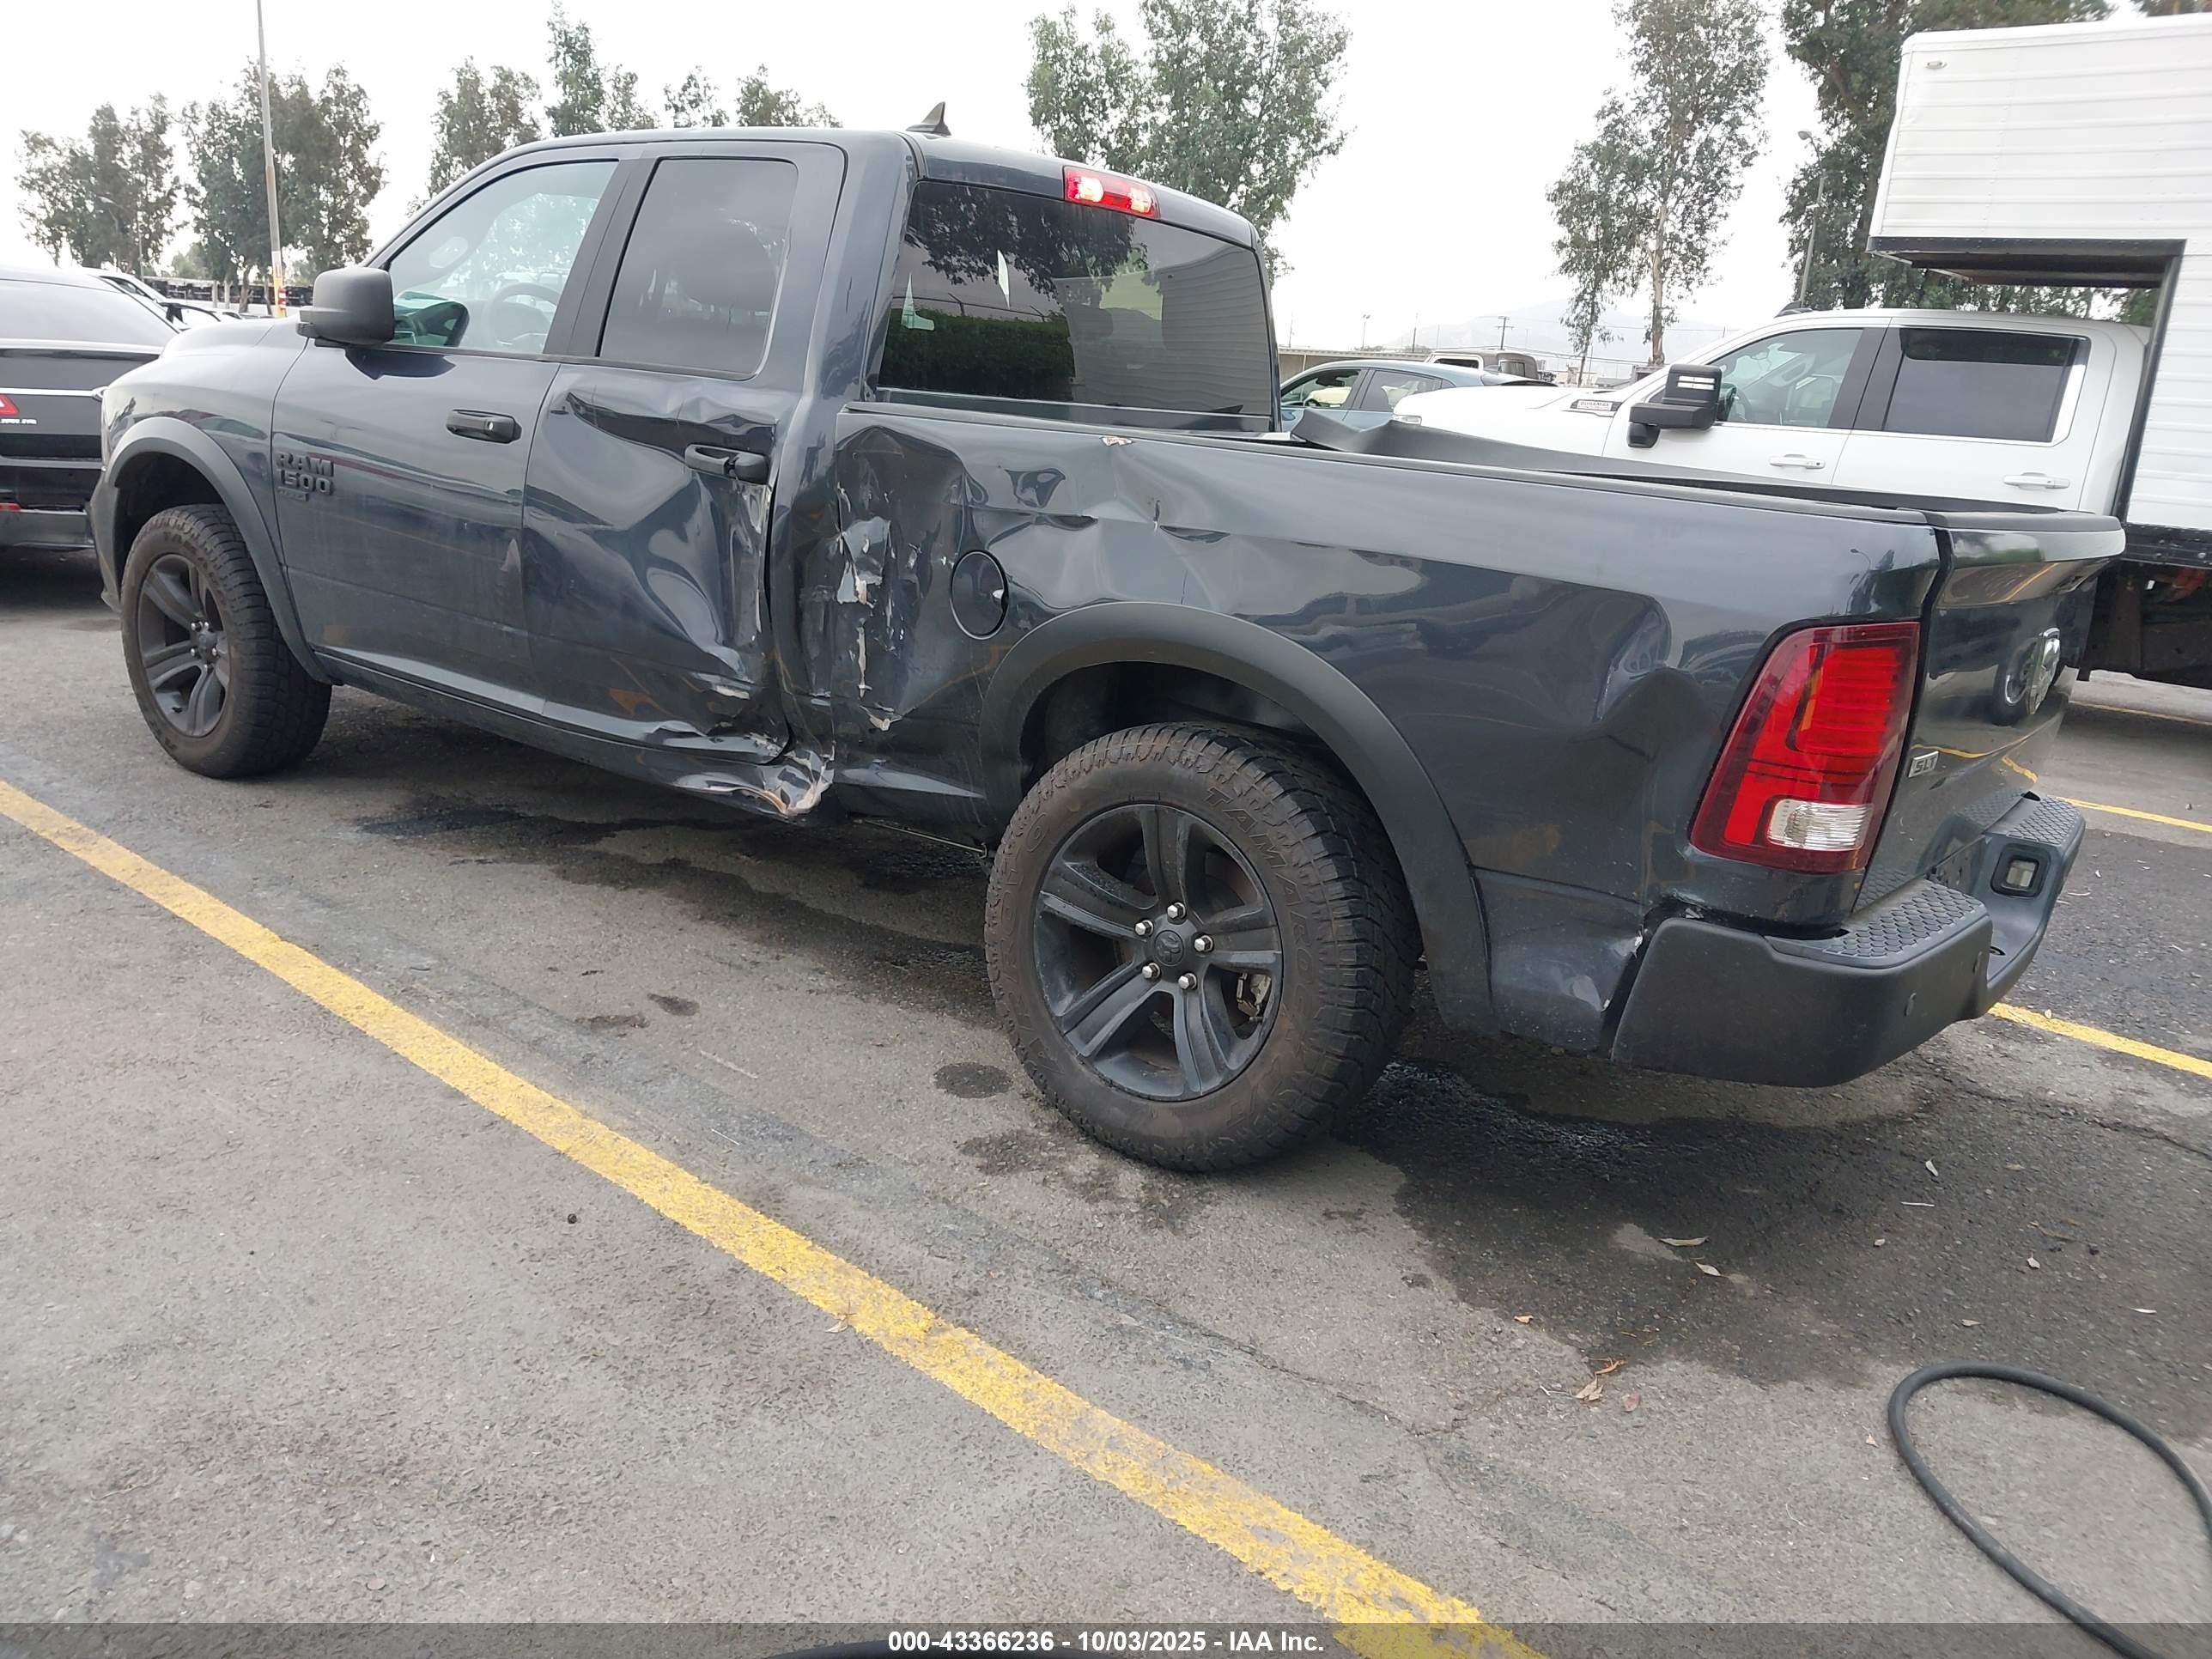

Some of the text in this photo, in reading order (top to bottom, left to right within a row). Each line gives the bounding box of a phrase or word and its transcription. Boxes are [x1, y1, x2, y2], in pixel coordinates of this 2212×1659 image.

[275, 452, 335, 477] RAM
[276, 468, 335, 496] 1500
[1913, 754, 1938, 774] SLT
